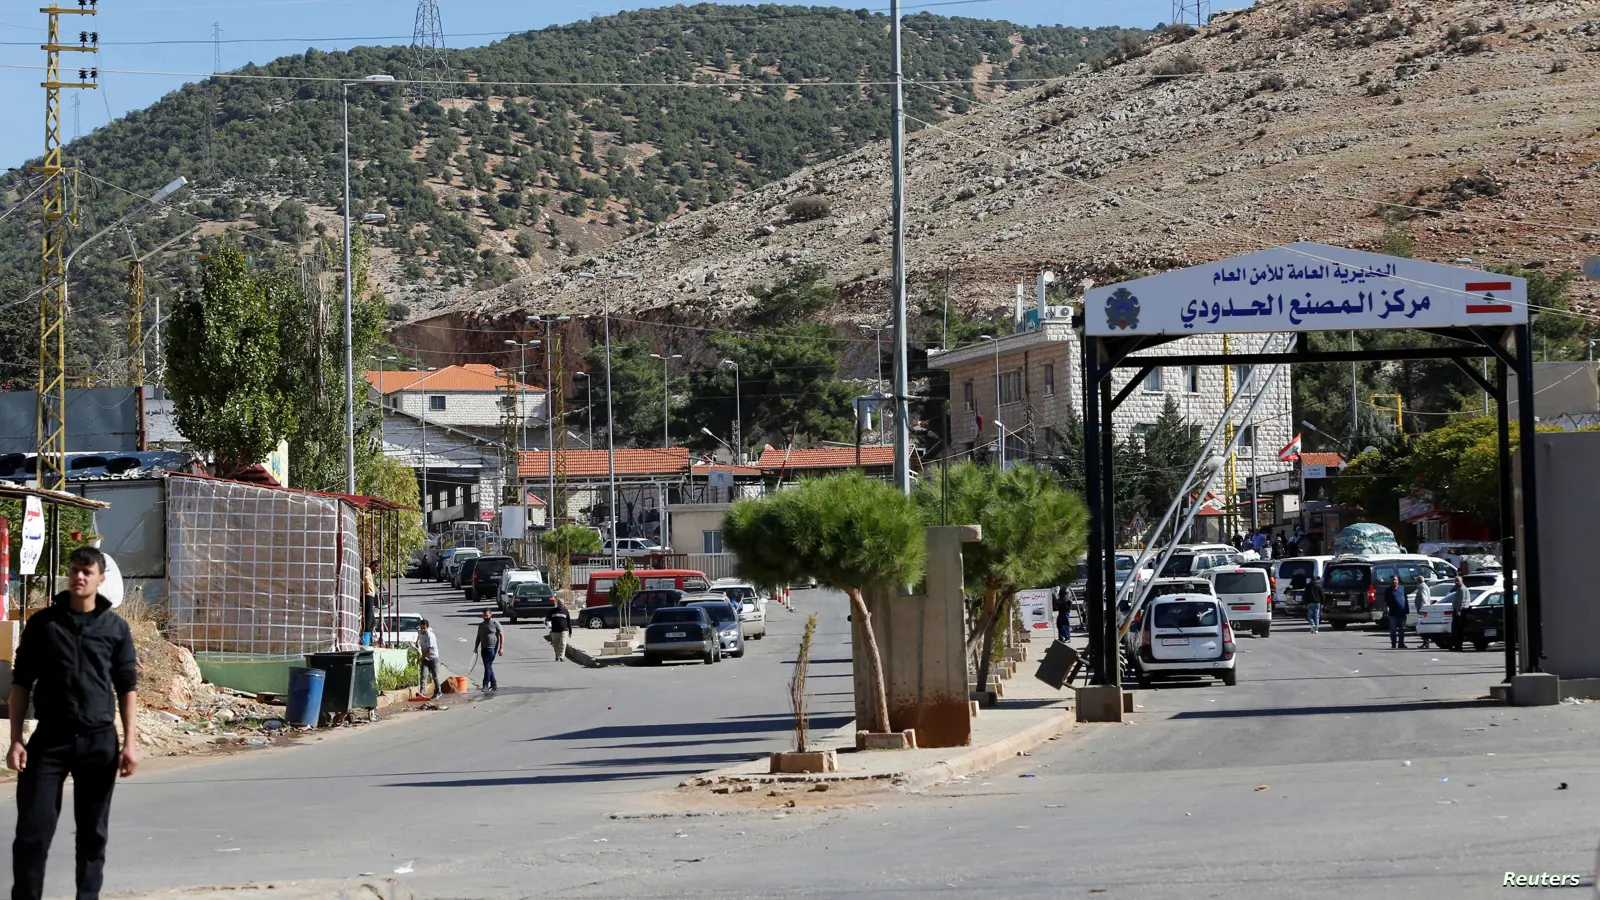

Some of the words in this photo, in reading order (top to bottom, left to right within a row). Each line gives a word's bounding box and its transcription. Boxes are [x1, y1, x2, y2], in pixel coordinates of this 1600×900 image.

[1212, 268, 1247, 287] العام
[1250, 264, 1285, 286] للأمن
[1287, 264, 1330, 280] العامة
[1332, 263, 1397, 285] المديرية
[1180, 294, 1284, 329] الحدودي
[1288, 290, 1374, 326] المصنع
[1376, 289, 1431, 319] مركز
